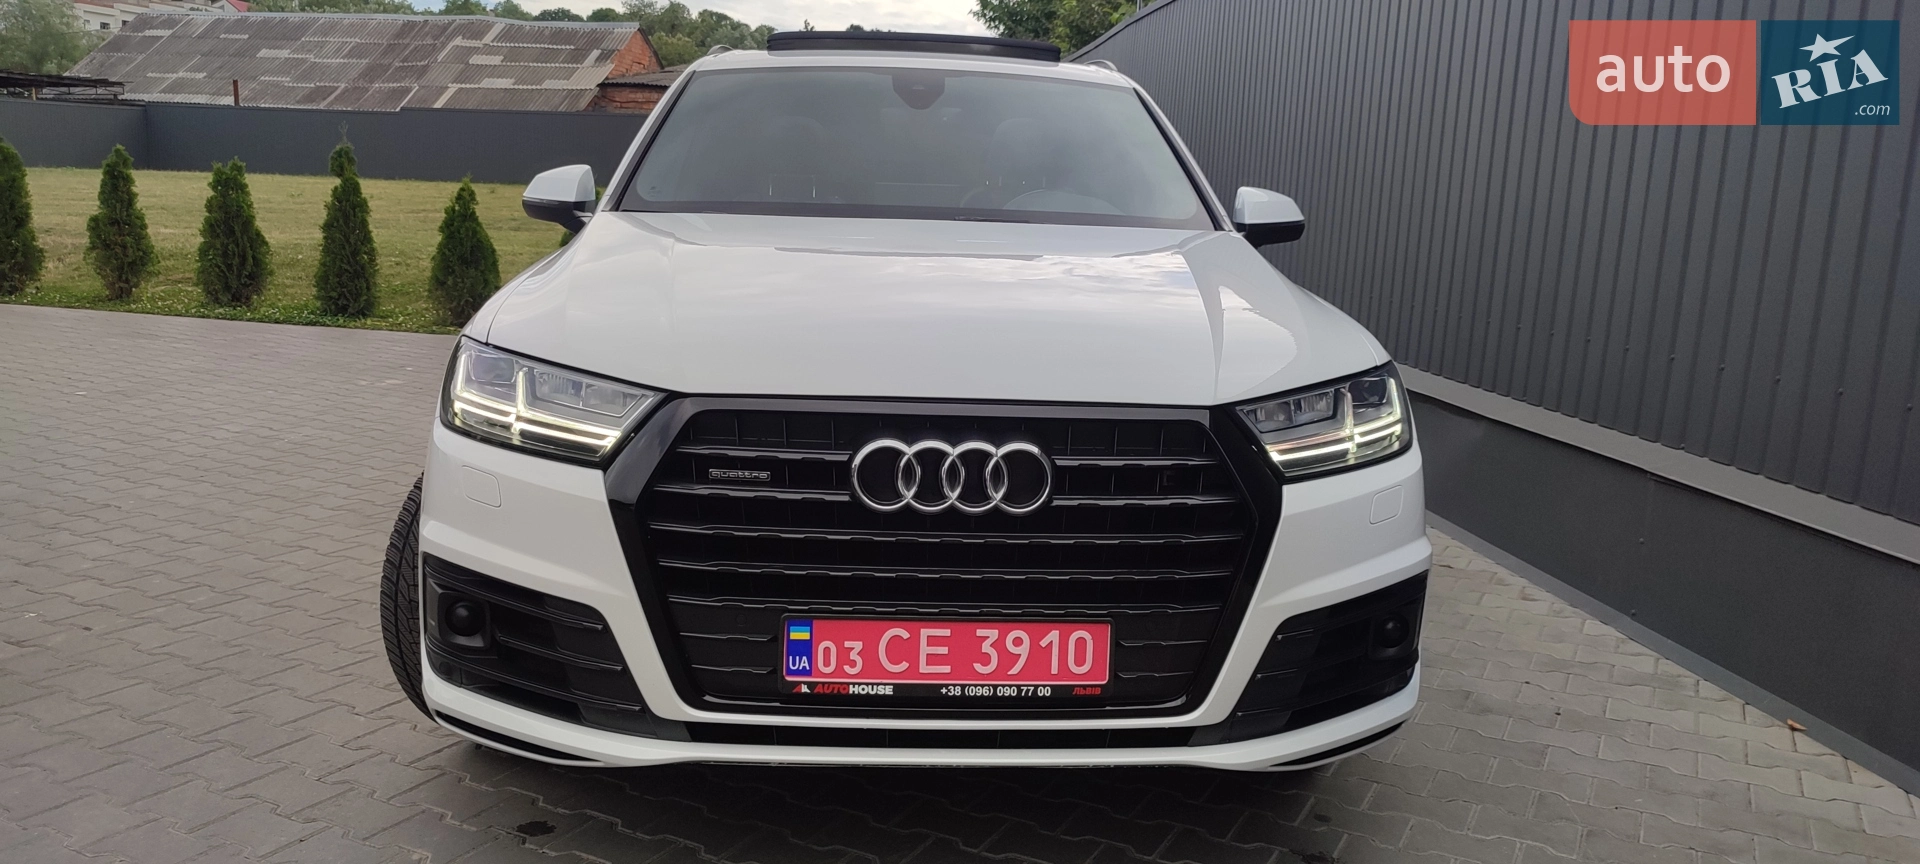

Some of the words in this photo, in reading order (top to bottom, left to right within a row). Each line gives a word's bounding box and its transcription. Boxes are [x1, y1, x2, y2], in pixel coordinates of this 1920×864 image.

[711, 471, 768, 479] quattro
[817, 640, 863, 675] 03
[878, 628, 951, 673] CE
[973, 629, 1093, 675] 3910
[789, 655, 810, 671] UA
[814, 684, 894, 695] AUTOHOUSE
[940, 686, 961, 696] +38
[965, 686, 993, 697] (096)
[996, 686, 1017, 696] 090
[1021, 686, 1034, 696] 77
[1037, 686, 1051, 696] 00
